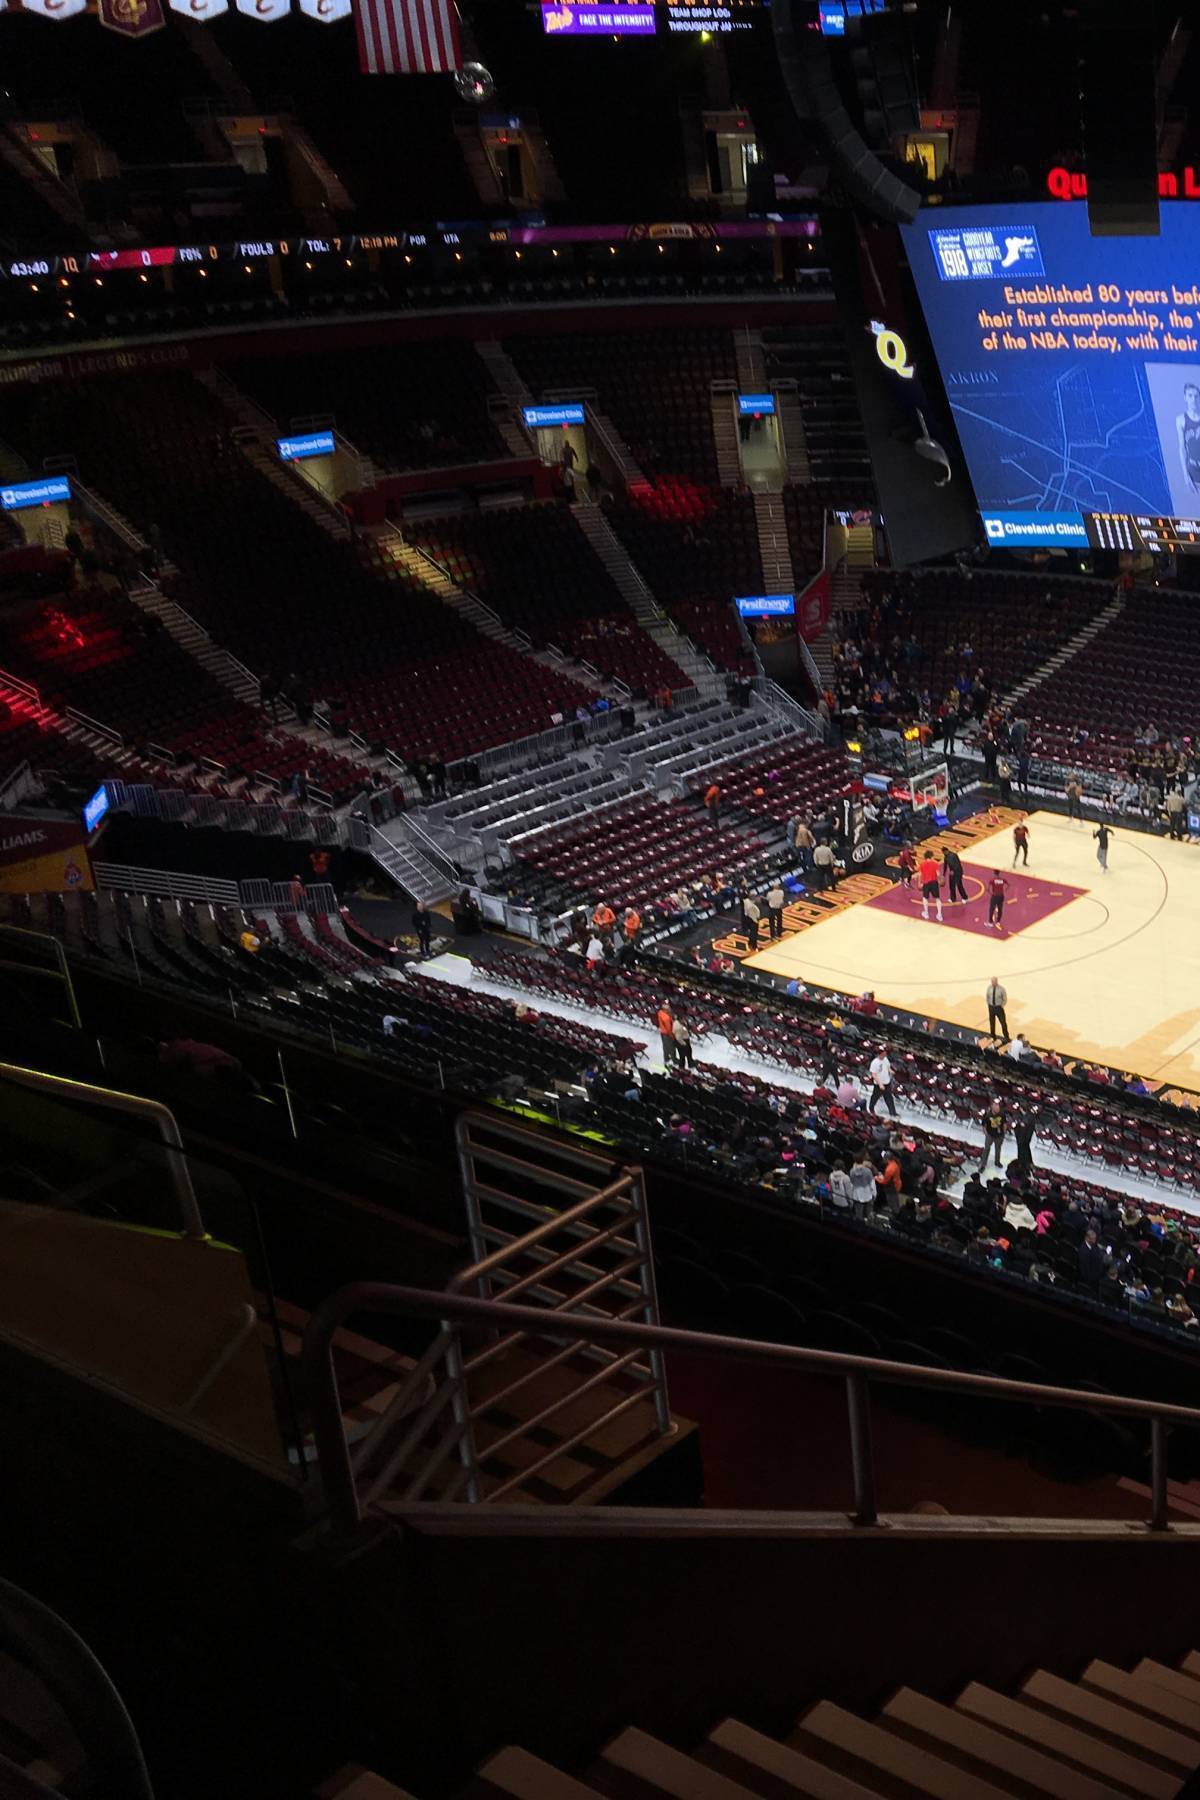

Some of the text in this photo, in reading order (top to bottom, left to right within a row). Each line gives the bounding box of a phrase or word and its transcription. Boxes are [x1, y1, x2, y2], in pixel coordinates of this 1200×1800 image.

[579, 14, 597, 26] FACE
[598, 14, 613, 26] THE
[613, 14, 654, 26] INTENSITY!
[10, 261, 49, 277] 43:40
[141, 251, 151, 266] 0
[208, 246, 218, 260] 0
[240, 242, 274, 257] FOULS
[280, 241, 289, 255] 0
[384, 236, 398, 248] PM
[443, 233, 460, 245] UTA
[966, 246, 1002, 261] WINGFOOTS
[940, 249, 969, 277] 1918
[1004, 284, 1093, 305] Established
[1098, 285, 1120, 304] 80
[1125, 288, 1168, 307] years
[978, 309, 1012, 328] their
[1017, 308, 1046, 327] first
[1051, 308, 1164, 331] championship,
[1169, 310, 1193, 328] the
[982, 332, 999, 350] of
[1002, 332, 1027, 350] the
[1030, 332, 1070, 350] NBA
[1072, 333, 1122, 354] today,
[1126, 332, 1159, 351] with
[1163, 332, 1198, 351] their
[876, 330, 914, 378] Q
[536, 411, 565, 420] Cleveland
[14, 483, 69, 501] Cleveland Clinic
[1005, 522, 1055, 536] Cleveland
[1057, 522, 1086, 535] Clinic
[738, 598, 790, 611] FirstEnergy
[855, 844, 871, 860] KIA
